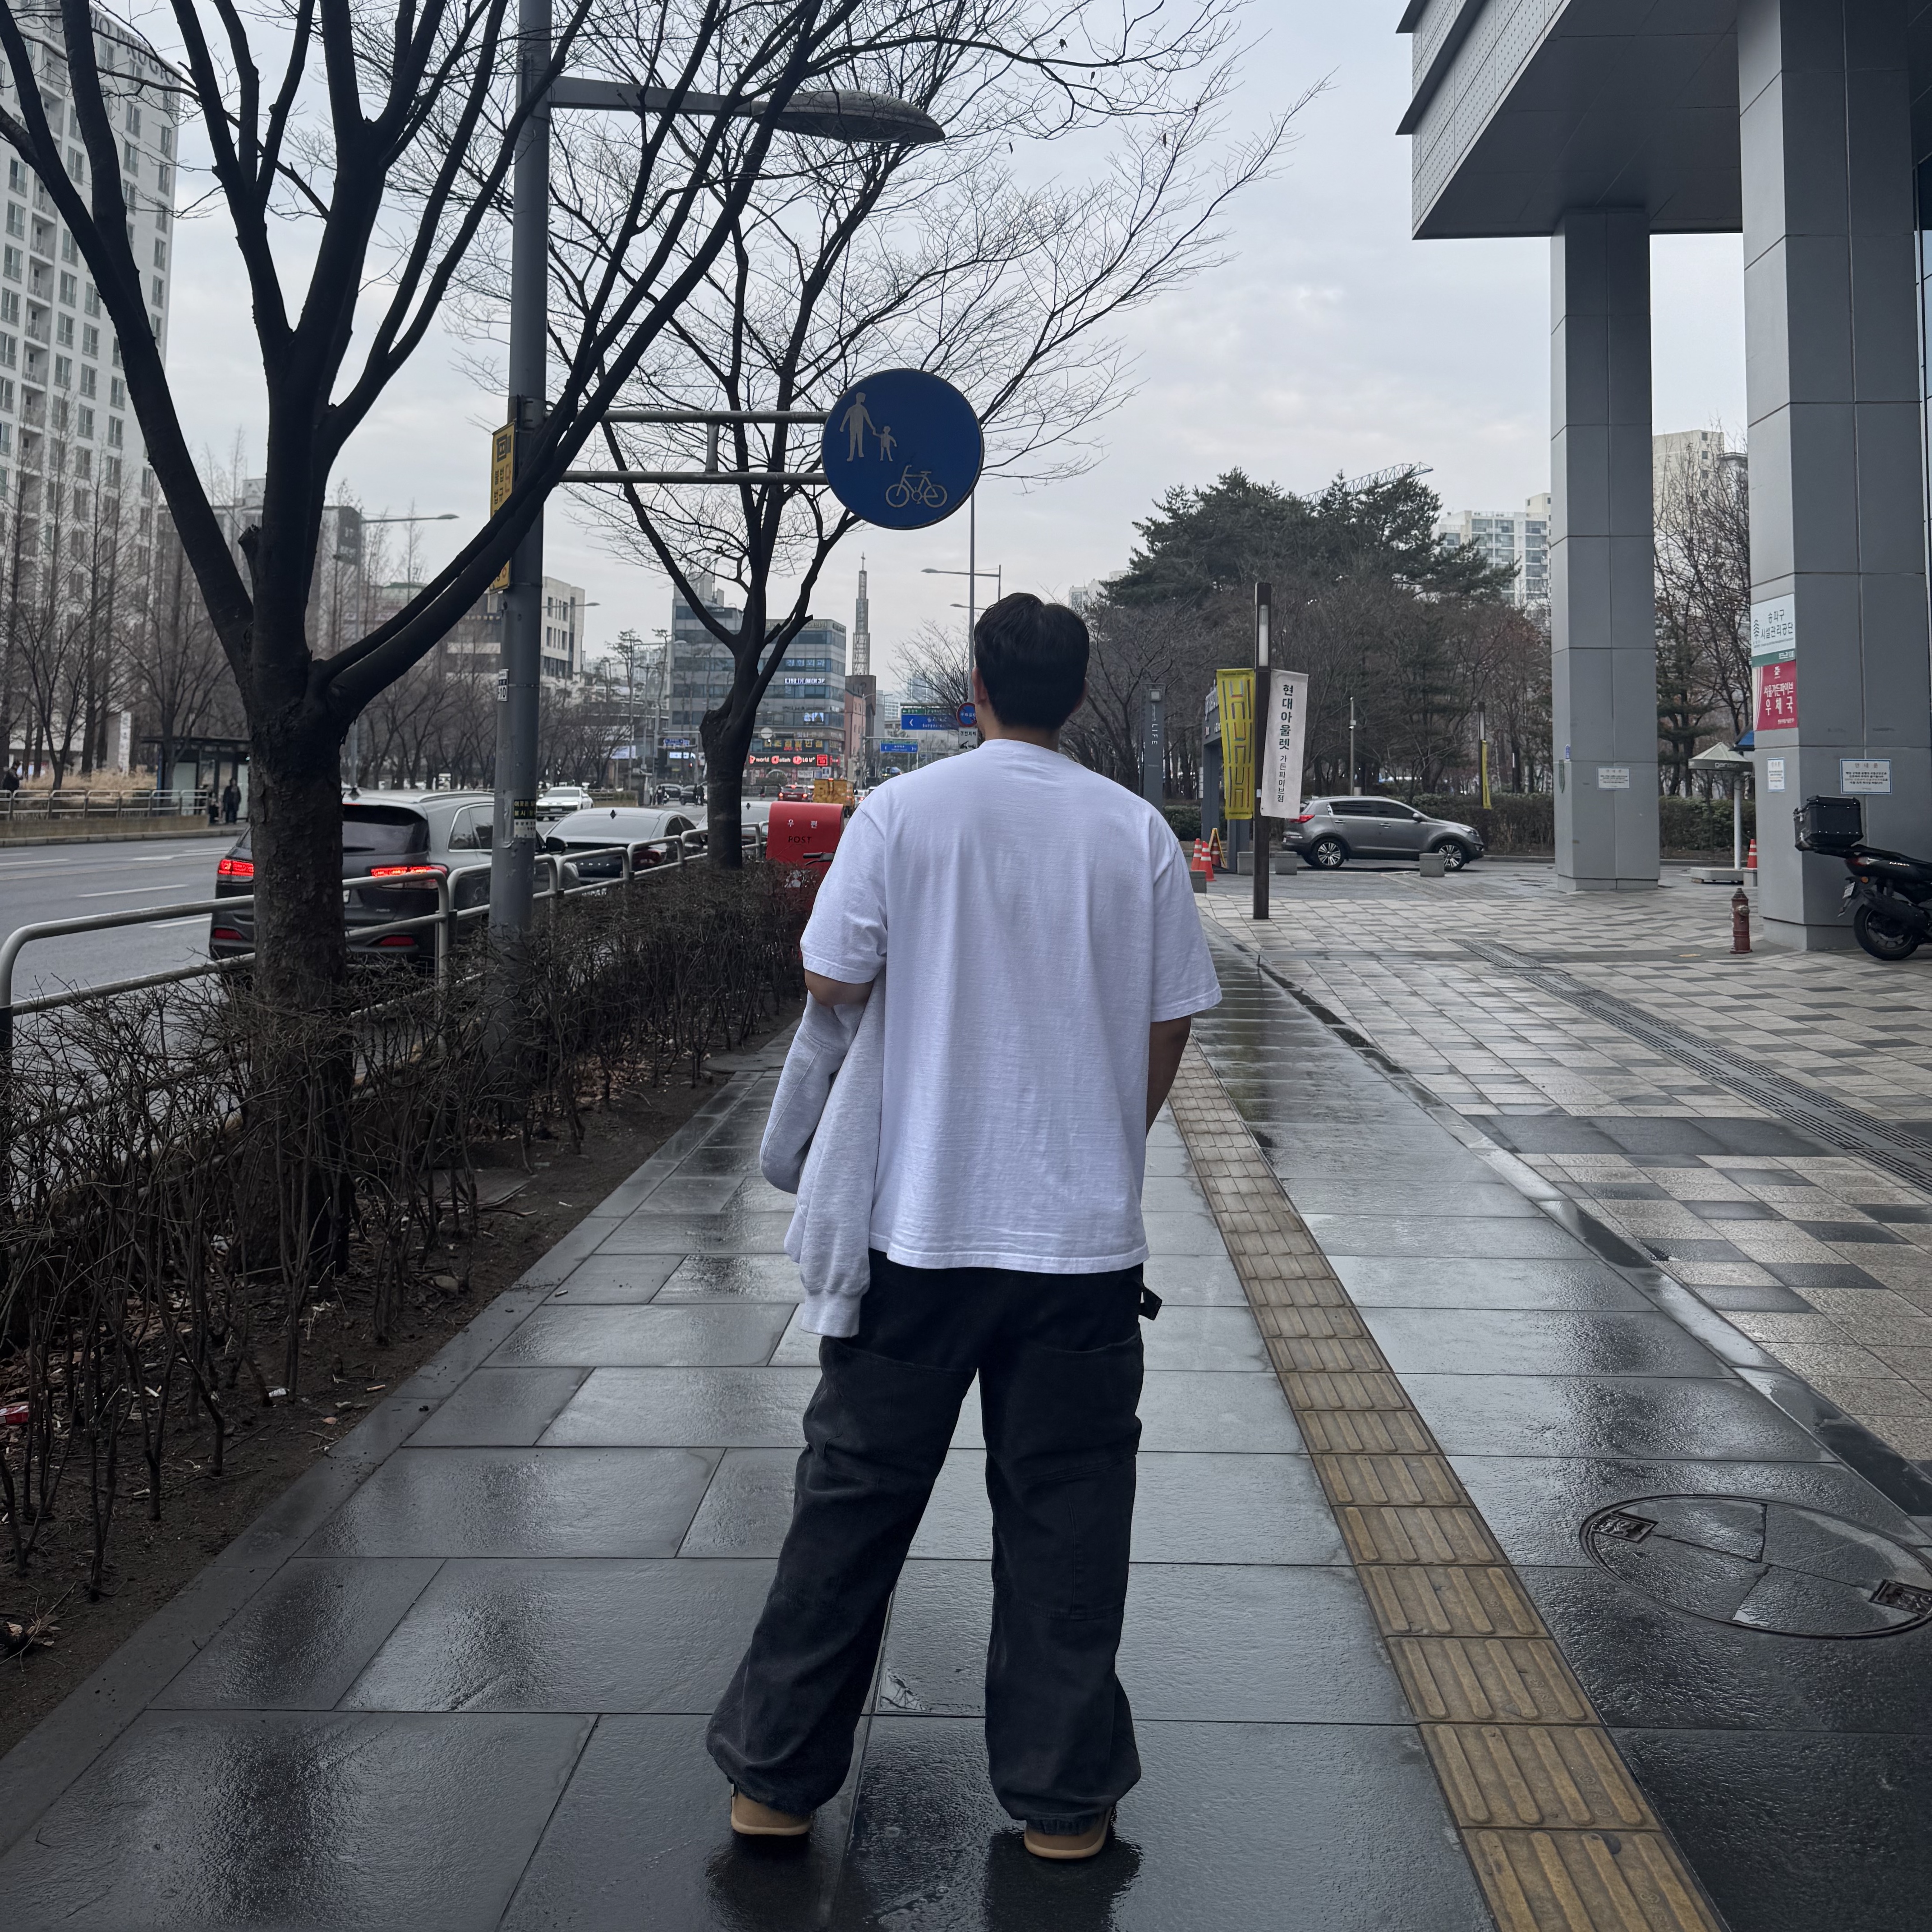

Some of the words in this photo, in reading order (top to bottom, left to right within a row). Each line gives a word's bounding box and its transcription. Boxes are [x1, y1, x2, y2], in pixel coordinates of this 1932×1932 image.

[1768, 609, 1784, 624] 송파구
[1761, 622, 1793, 639] 시설관리공단
[1764, 681, 1793, 698] 서울가든파이브
[1765, 696, 1793, 716] 우체국
[1279, 684, 1293, 750] 현대아울렛
[1277, 755, 1287, 803] 가든파이브점
